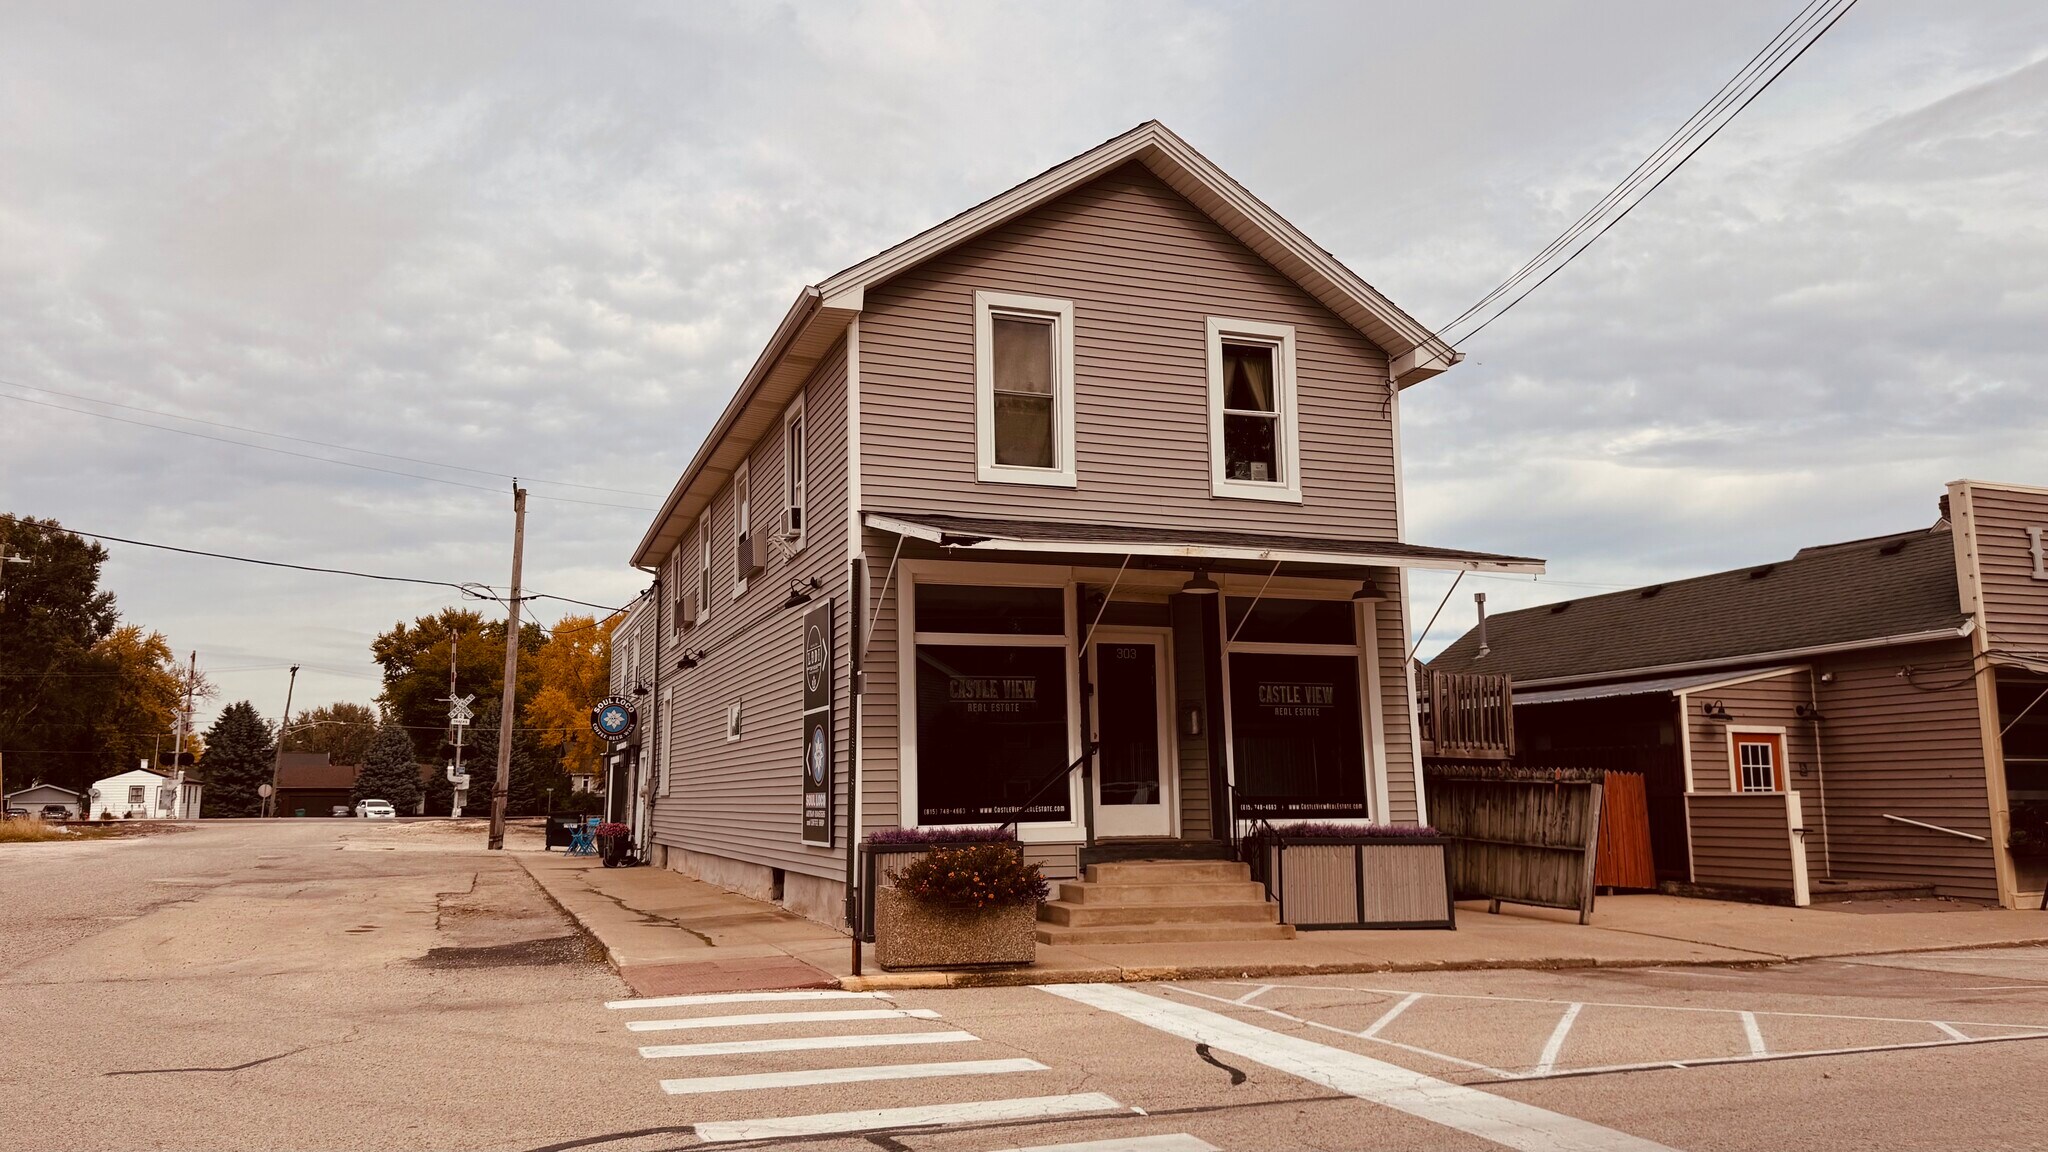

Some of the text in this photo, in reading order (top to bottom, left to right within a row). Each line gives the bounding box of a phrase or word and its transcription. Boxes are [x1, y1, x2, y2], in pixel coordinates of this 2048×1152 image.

[1116, 648, 1137, 659] 303
[950, 680, 1036, 699] CASTLE VIEW
[1259, 685, 1333, 704] CASTLE VIEW
[593, 697, 635, 714] SOUL LOCO
[967, 703, 1020, 712] REAL ESTATE
[1274, 707, 1320, 716] REAL ESTATE
[593, 723, 607, 739] COFFEE
[624, 724, 635, 736] WINE
